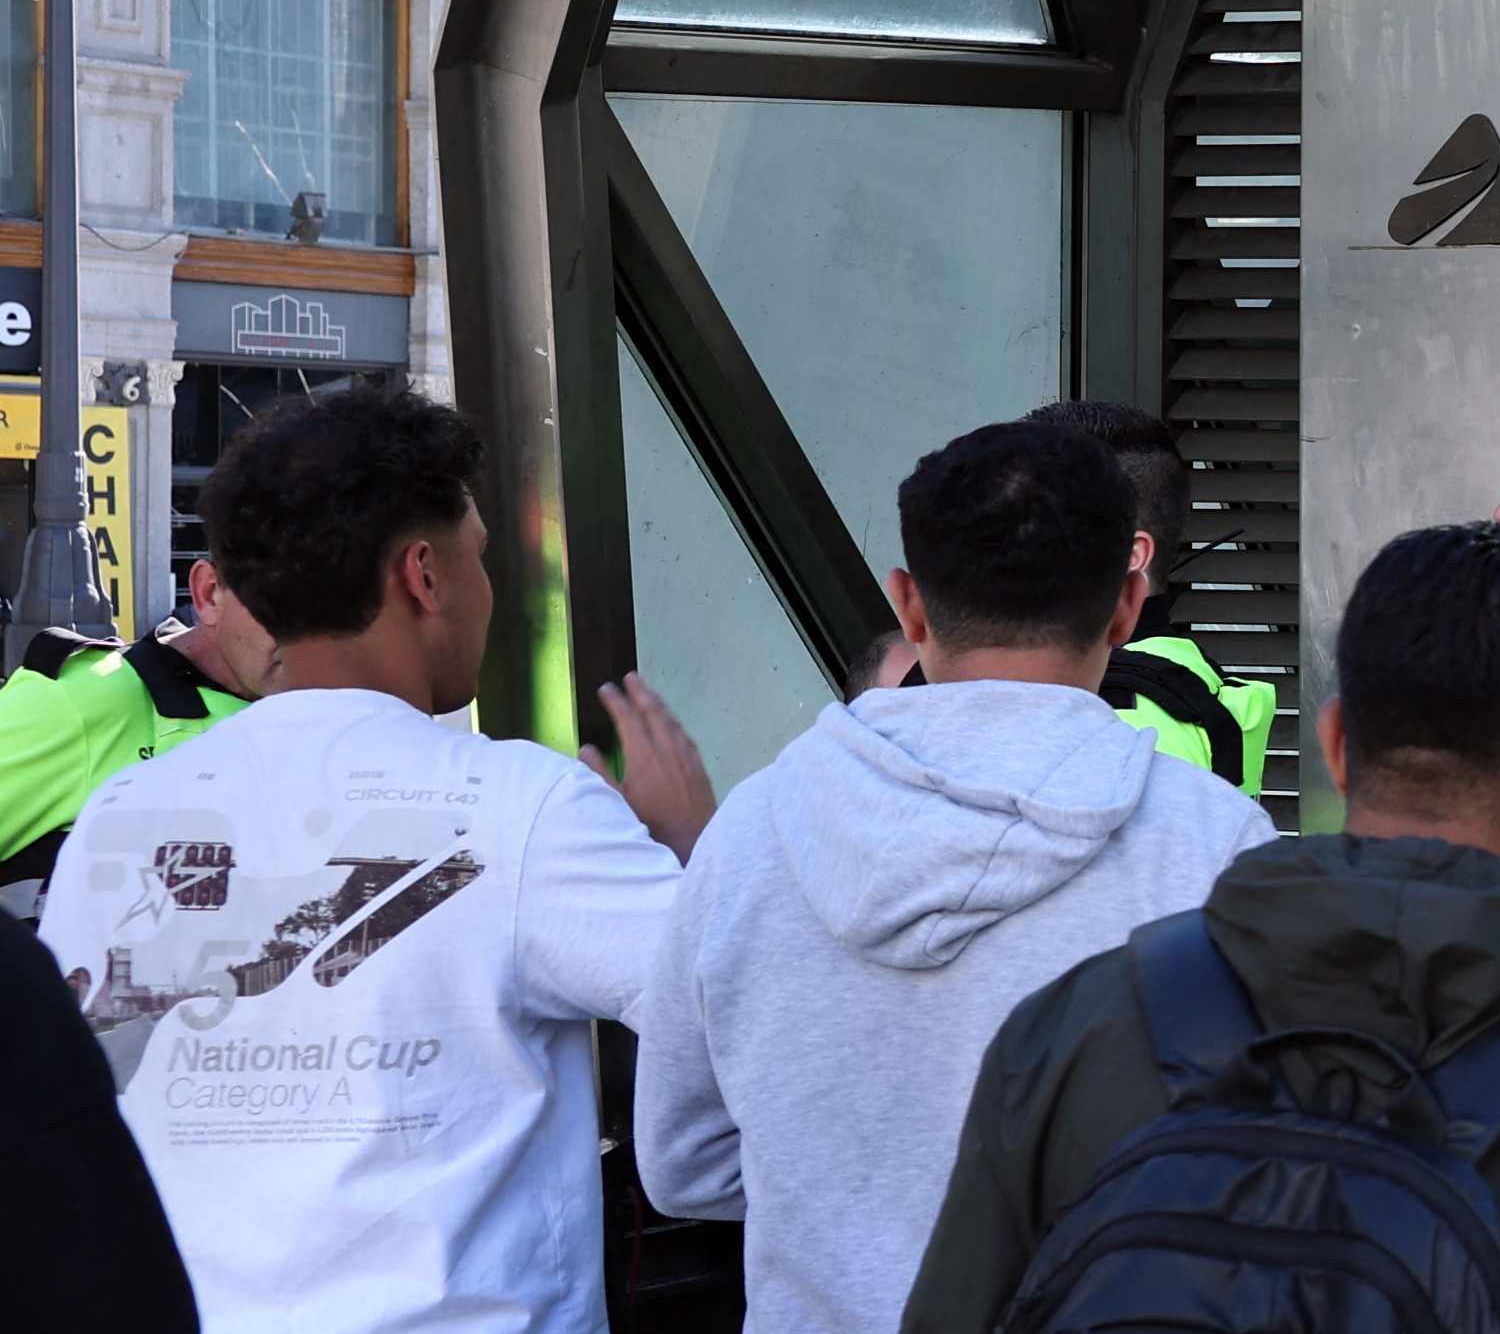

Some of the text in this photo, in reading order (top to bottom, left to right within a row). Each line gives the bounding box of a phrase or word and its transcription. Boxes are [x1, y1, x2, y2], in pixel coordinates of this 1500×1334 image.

[123, 375, 140, 401] 6
[344, 788, 440, 803] CIRCUIT
[177, 940, 252, 1031] 5
[167, 1034, 441, 1078] National Cup
[165, 1076, 353, 1116] Category A
